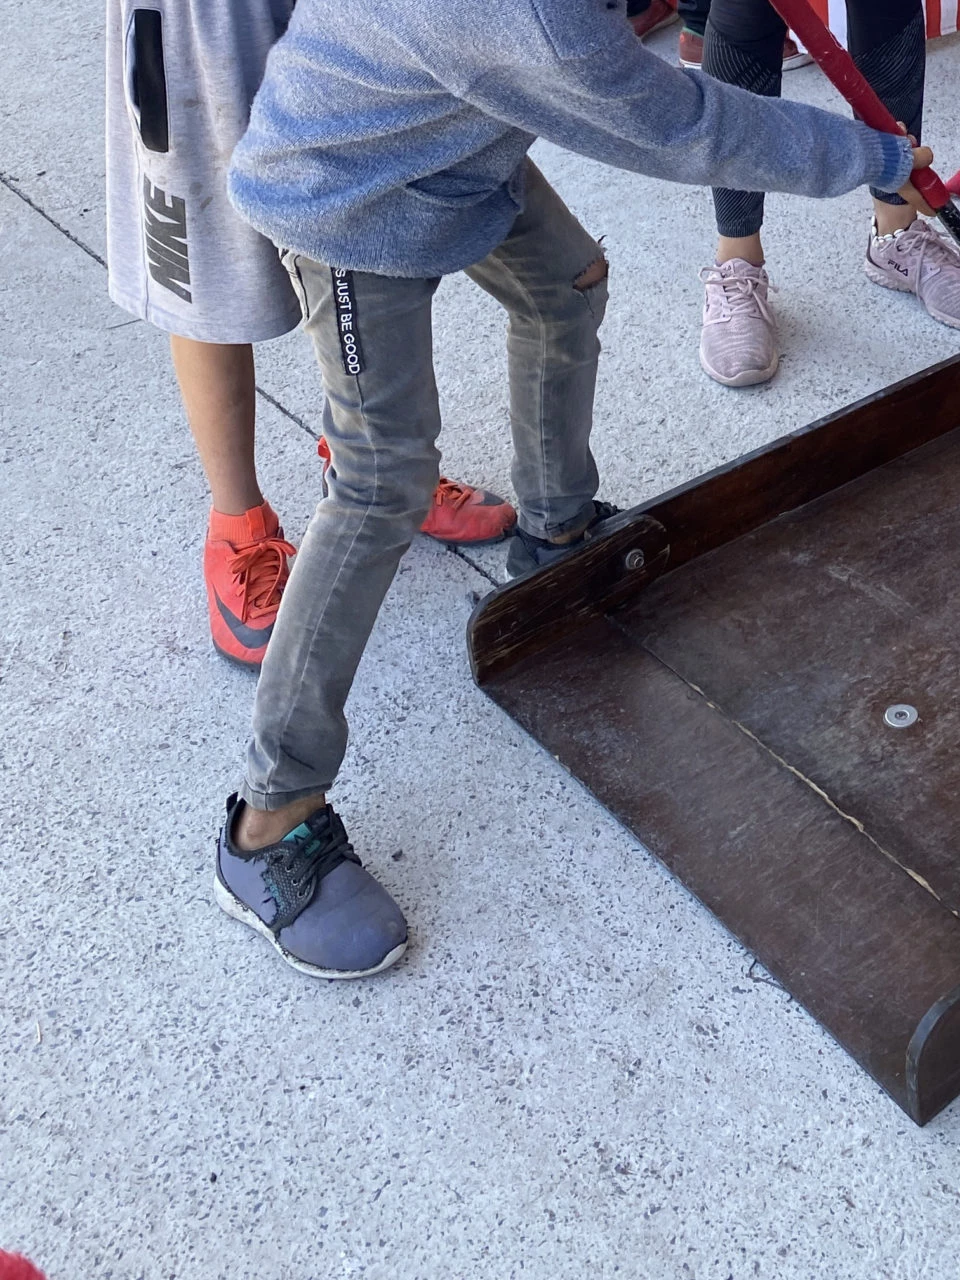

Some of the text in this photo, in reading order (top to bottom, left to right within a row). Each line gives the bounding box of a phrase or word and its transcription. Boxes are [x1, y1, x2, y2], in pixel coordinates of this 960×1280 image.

[143, 171, 193, 305] NIKE
[887, 258, 909, 277] FILA
[336, 279, 352, 310] JUST
[340, 313, 353, 332] BE
[343, 333, 361, 374] GOOD
